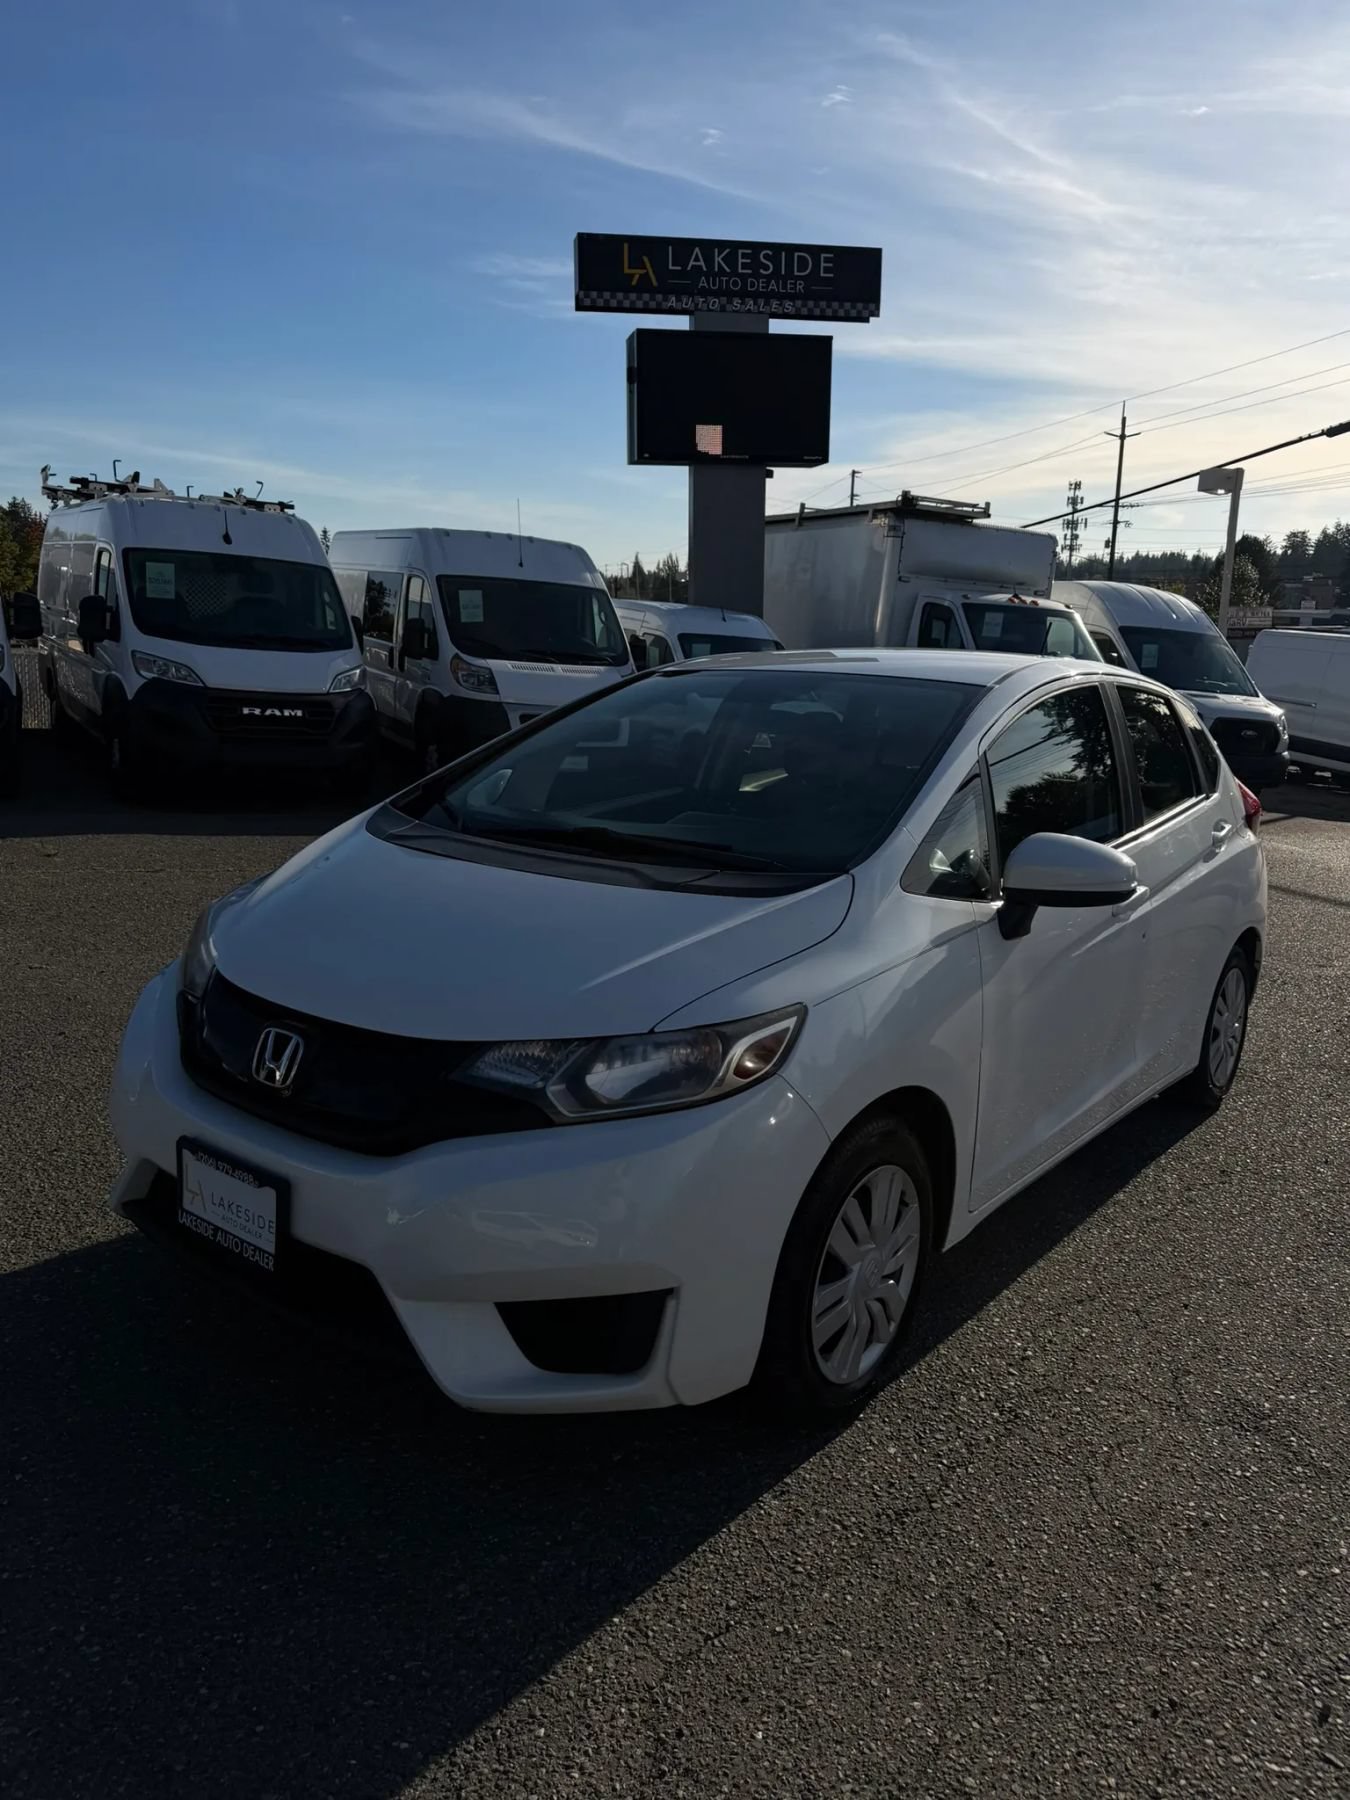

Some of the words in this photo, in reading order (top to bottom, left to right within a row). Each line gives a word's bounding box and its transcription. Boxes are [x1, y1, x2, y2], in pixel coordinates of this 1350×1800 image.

[668, 245, 835, 277] LAKESIDE
[698, 276, 742, 290] AUTO
[747, 278, 805, 293] DEALER
[667, 296, 719, 310] AUTO
[731, 299, 795, 313] SALES
[241, 706, 304, 717] RAM
[211, 1191, 275, 1235] LAKESIDE
[221, 1214, 238, 1228] AUTO
[239, 1222, 263, 1240] DEALER
[178, 1209, 215, 1240] LAKESIDE
[215, 1231, 241, 1253] AUTO
[243, 1242, 275, 1272] DEALER
